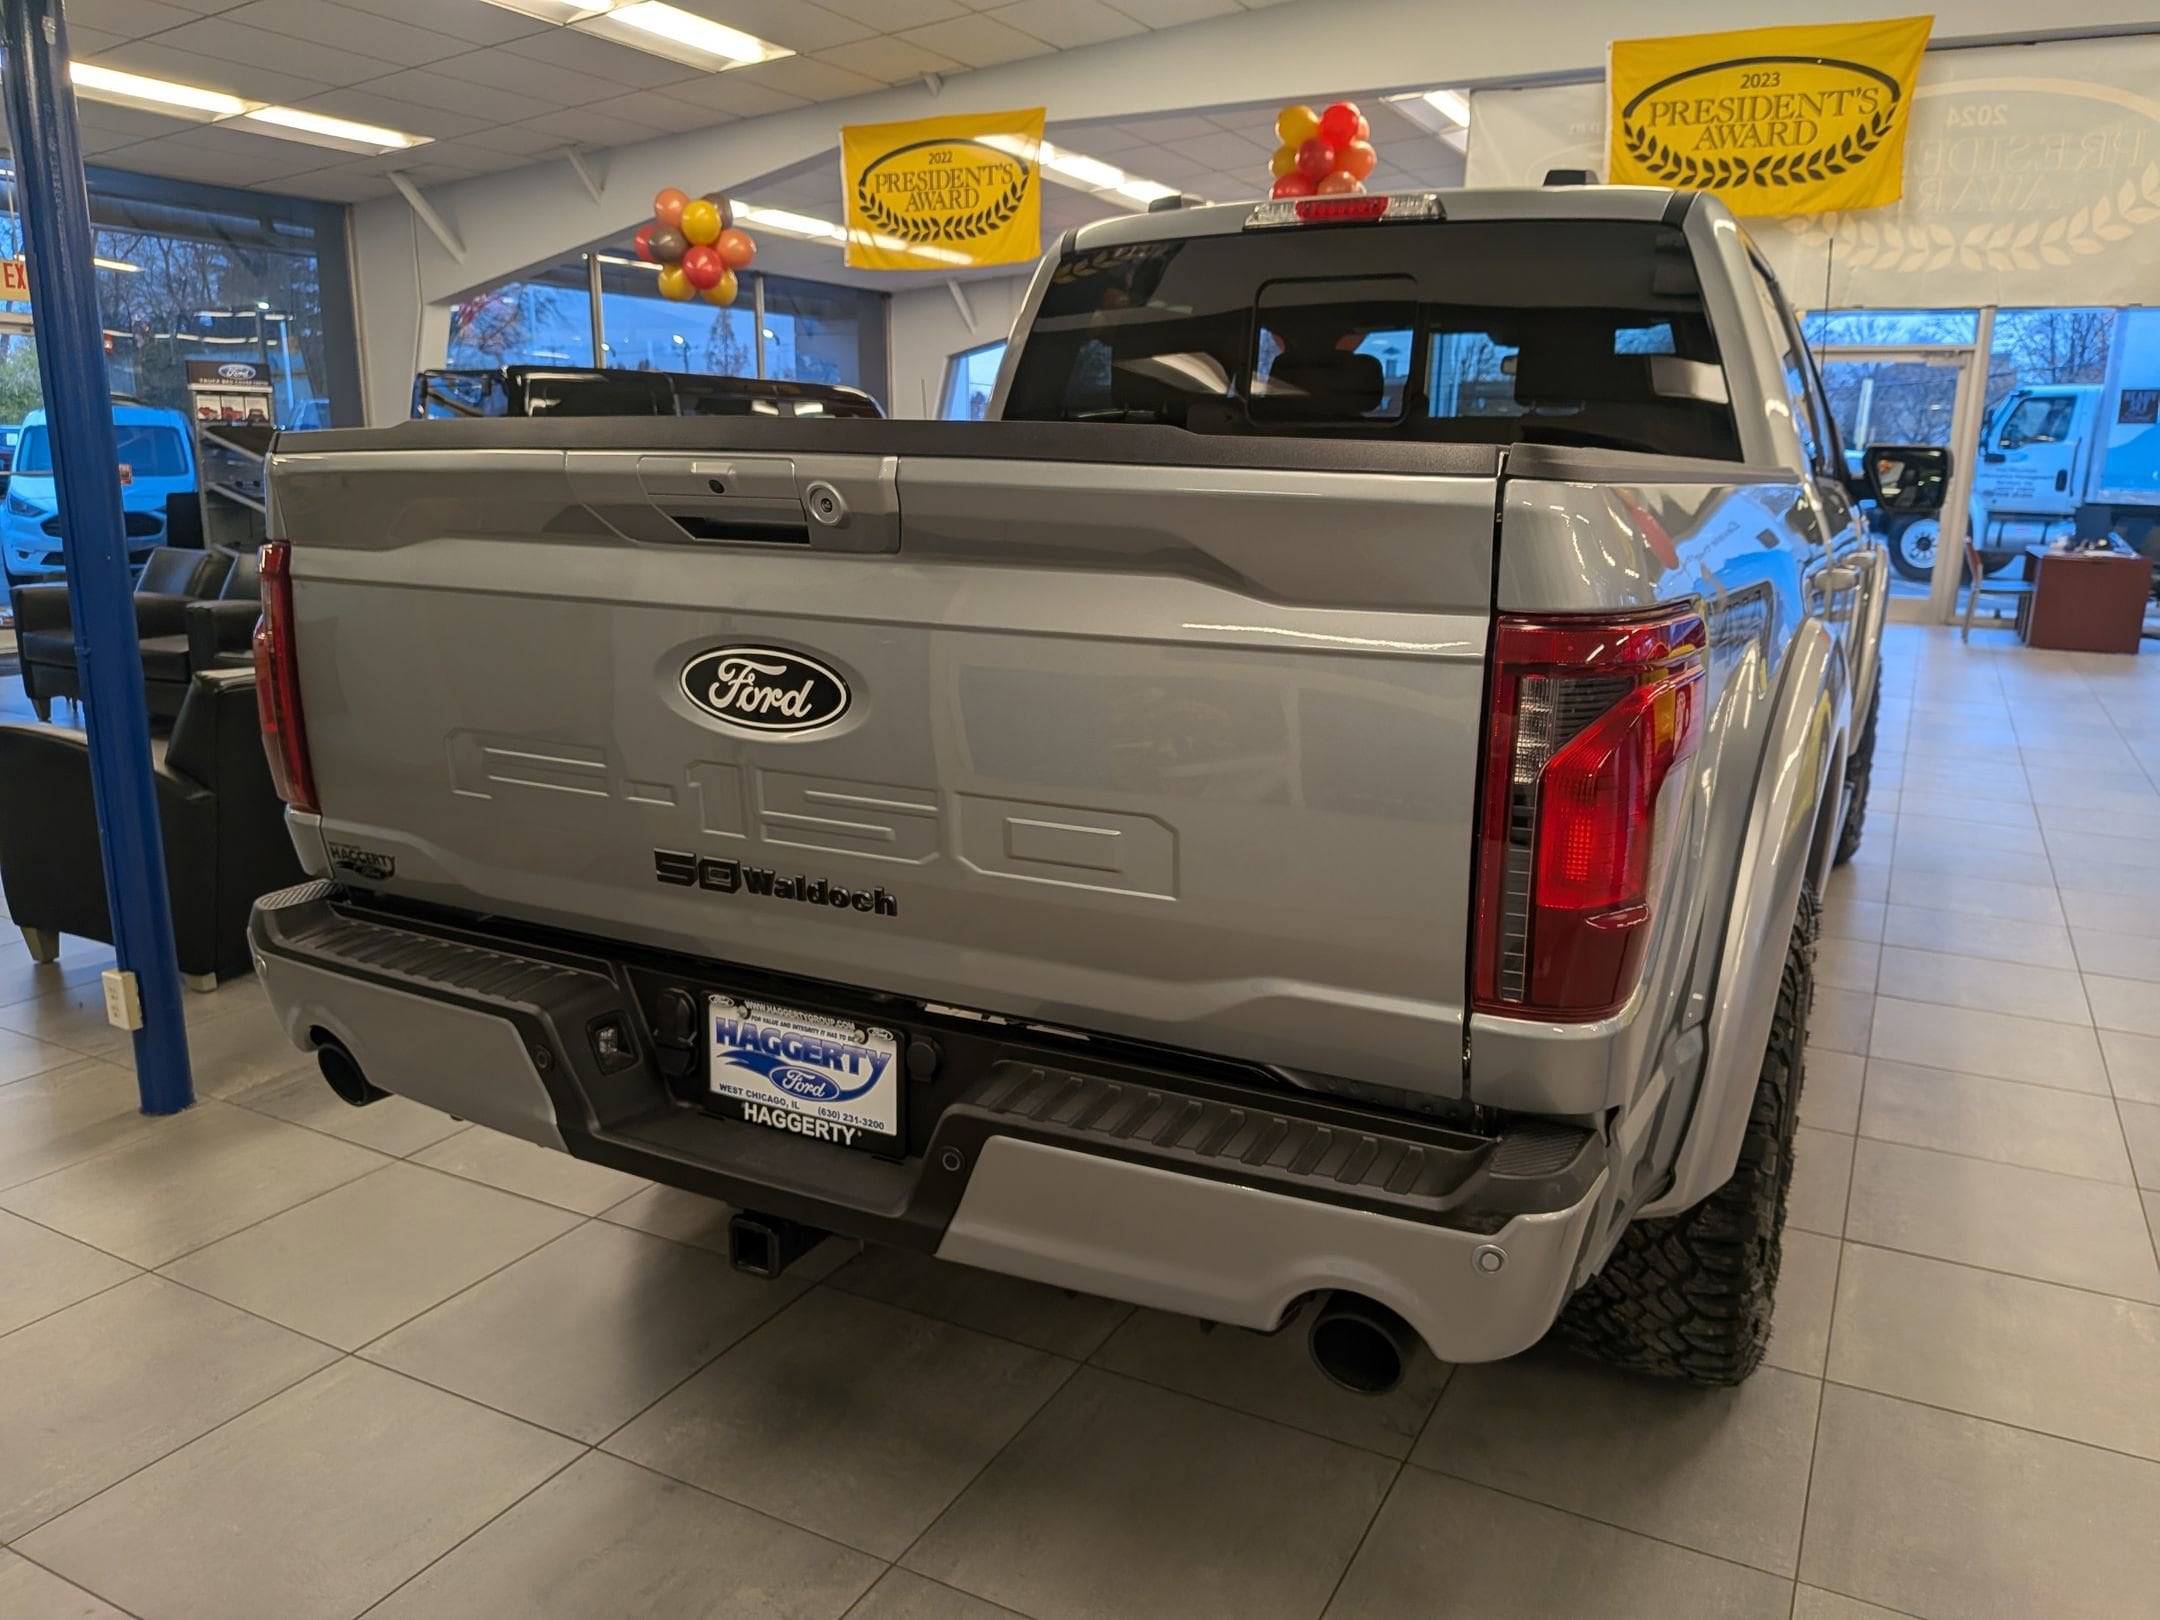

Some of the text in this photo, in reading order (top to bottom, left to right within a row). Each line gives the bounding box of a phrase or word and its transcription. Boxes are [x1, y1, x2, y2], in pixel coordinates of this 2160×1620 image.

[1740, 72, 1781, 89] 2023
[1648, 87, 1879, 127] PRESIDENT'S
[1692, 120, 1818, 151] AWARD
[928, 151, 953, 165] 2022
[874, 163, 1014, 193] PRESIDENT'S
[905, 188, 980, 213] AWARD
[3, 262, 27, 289] EX
[708, 658, 815, 718] Ford
[742, 865, 898, 917] Waldoch
[744, 999, 857, 1031] WWW.HAGGERTYGROUP.COM
[751, 1015, 762, 1023] FOR
[763, 1017, 780, 1027] VALUE
[780, 1021, 791, 1029] AND
[792, 1023, 820, 1036] INTEGRITY
[839, 1033, 847, 1041] TO
[716, 1016, 892, 1076] HAGGERTY
[719, 1082, 801, 1110] WEST CHICAGO, IL
[782, 1069, 826, 1098] Ford
[744, 1102, 856, 1145] HAGGERTY
[817, 1106, 885, 1130] (630) 231-3200
